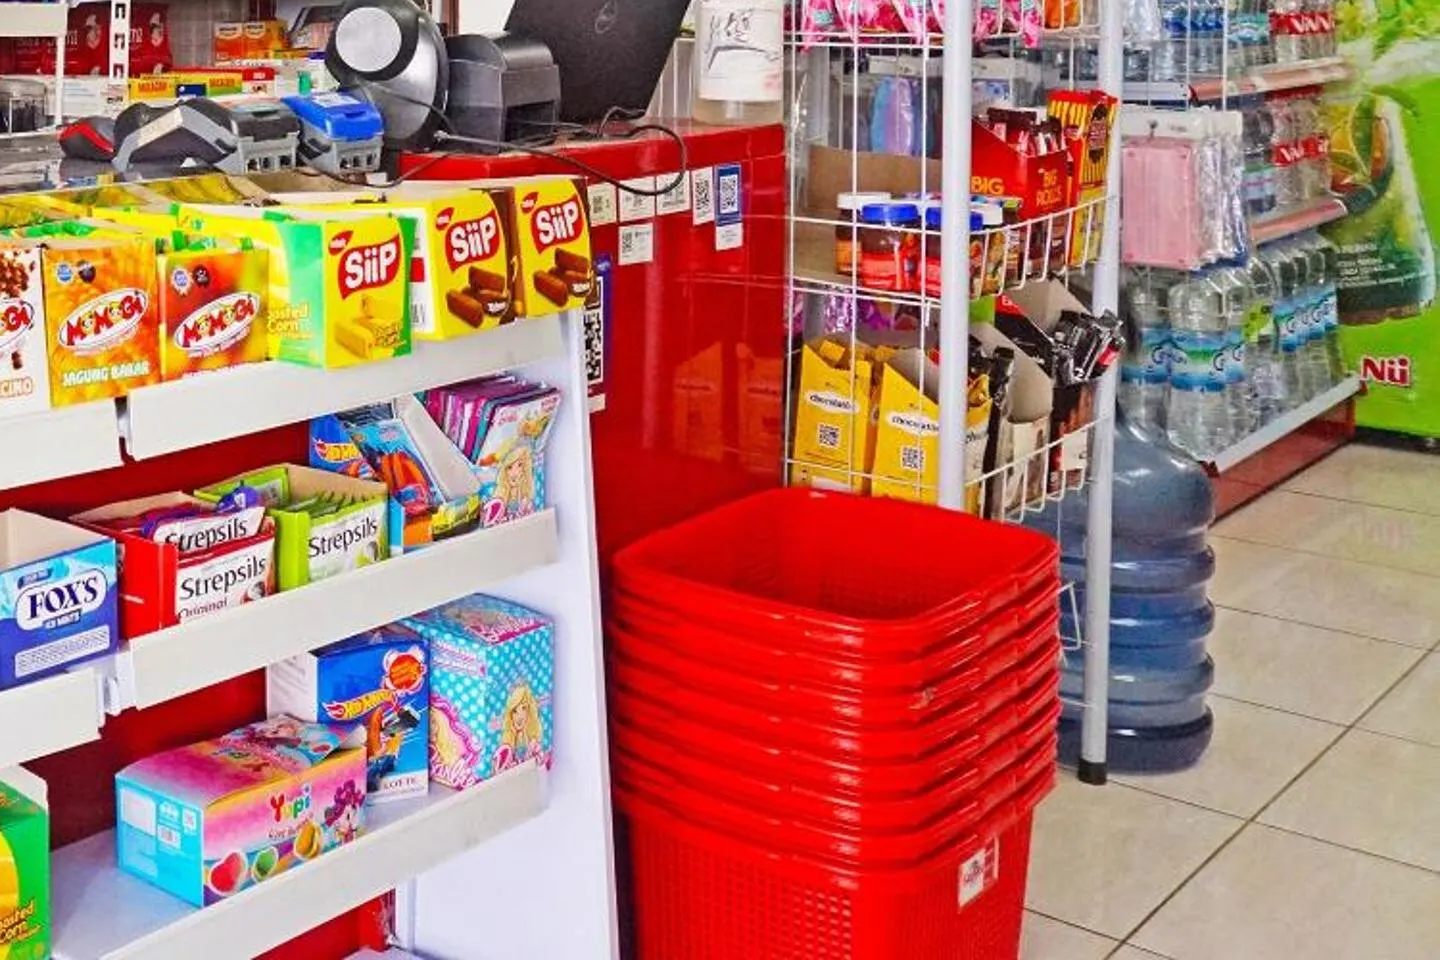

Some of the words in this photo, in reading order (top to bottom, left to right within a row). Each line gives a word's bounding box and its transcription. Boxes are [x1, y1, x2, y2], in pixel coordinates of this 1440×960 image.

[971, 175, 1005, 195] BIG
[450, 217, 498, 263] SiiP
[536, 199, 578, 246] SiiP
[344, 241, 397, 290] SiiP
[308, 515, 378, 558] Strepsils
[26, 575, 100, 622] FOX'S
[180, 555, 267, 601] Strepsils
[270, 783, 311, 823] Yupi
